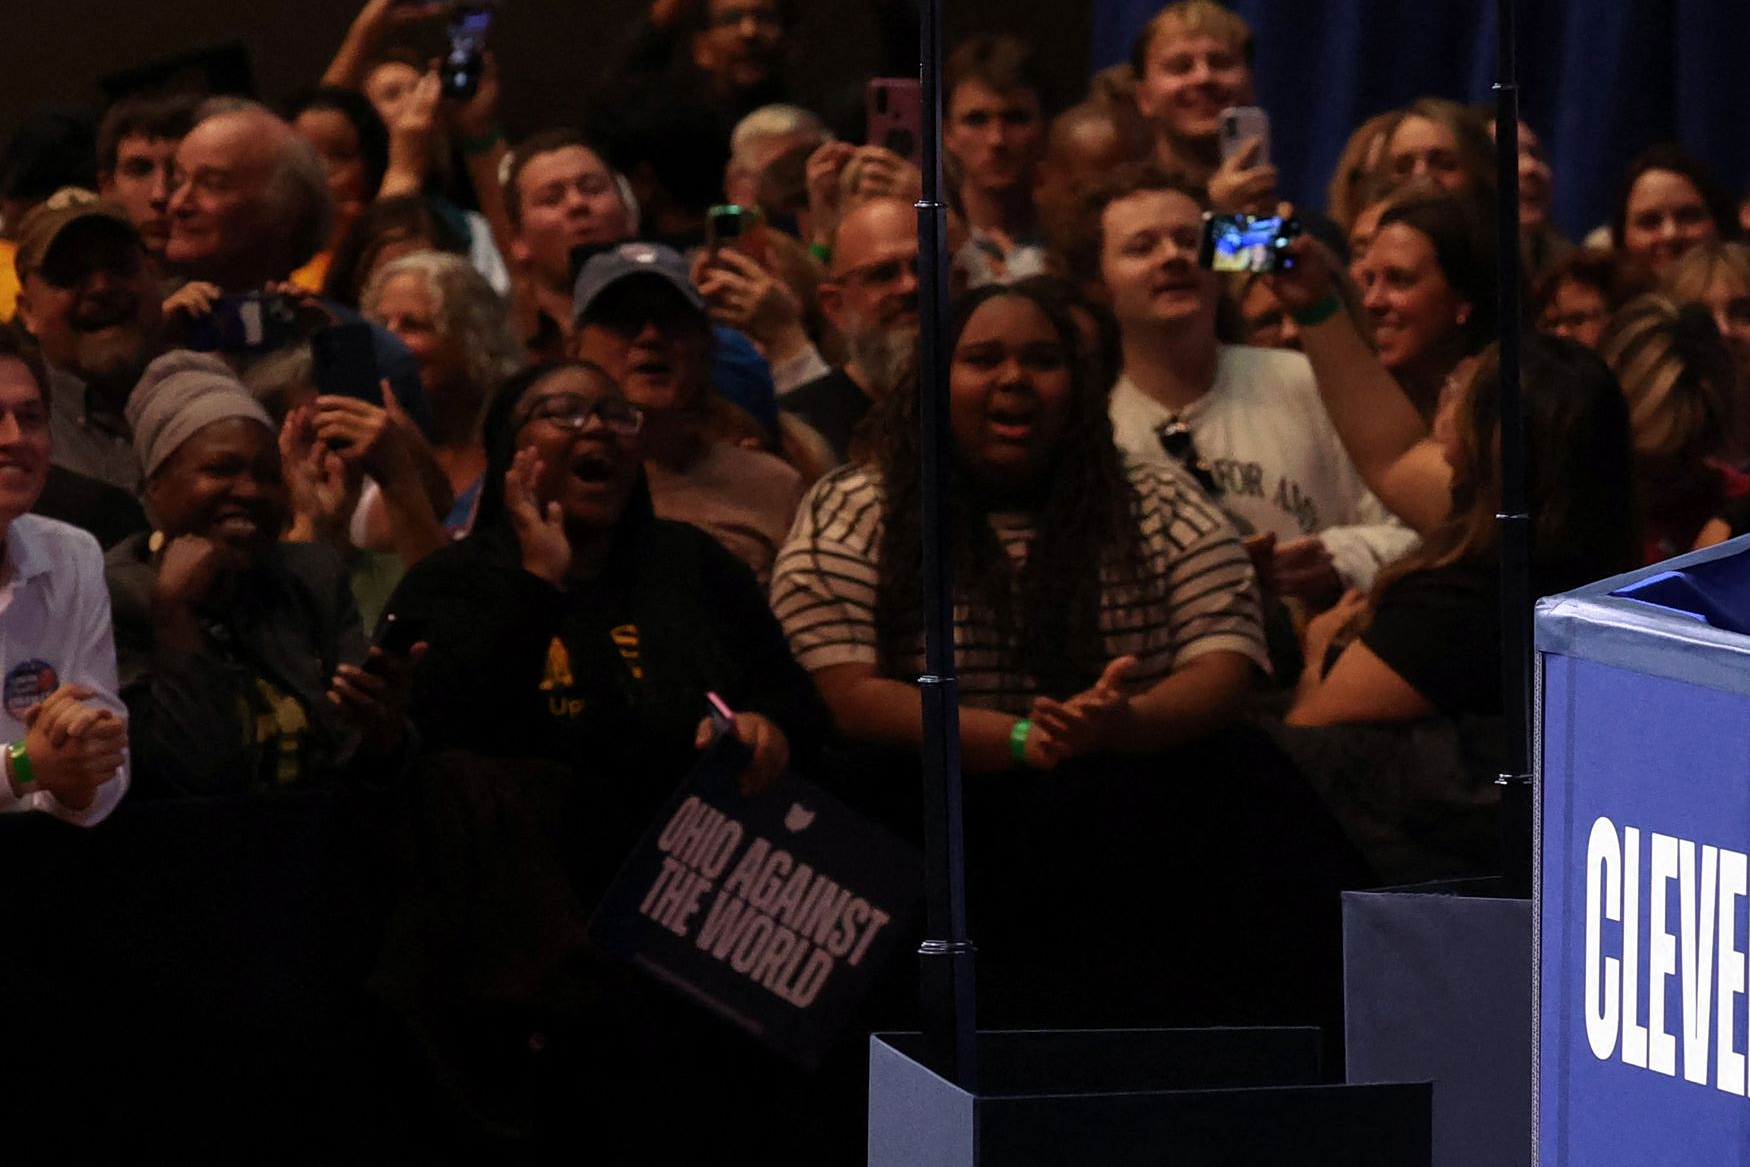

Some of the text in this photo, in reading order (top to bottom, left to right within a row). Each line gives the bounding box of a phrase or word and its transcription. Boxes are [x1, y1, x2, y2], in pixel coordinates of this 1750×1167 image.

[639, 856, 836, 1009] THE WORLD
[657, 795, 892, 967] OHIO AGAINST
